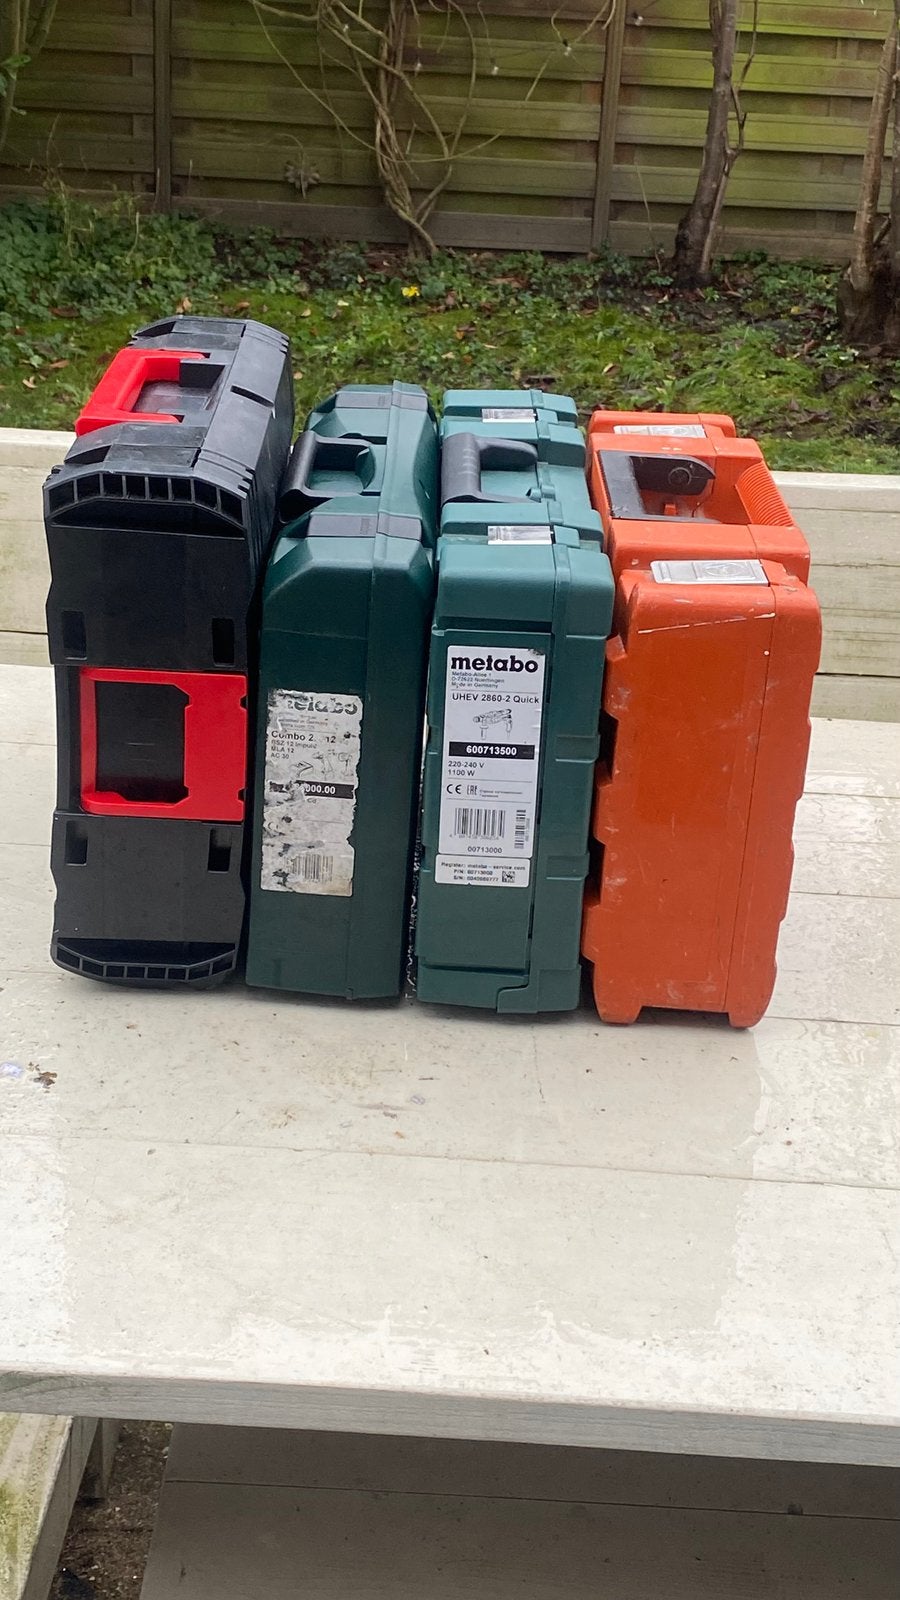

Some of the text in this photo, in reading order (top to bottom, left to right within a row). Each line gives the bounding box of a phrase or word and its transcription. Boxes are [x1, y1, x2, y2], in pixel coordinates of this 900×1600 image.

[450, 655, 538, 673] metabo
[452, 692, 540, 704] UHEV 2860-2 Quick
[271, 730, 306, 741] Combo
[466, 745, 517, 755] 600713500
[447, 760, 478, 769] 220-240
[447, 769, 466, 777] 1100
[467, 846, 503, 854] 00713000
